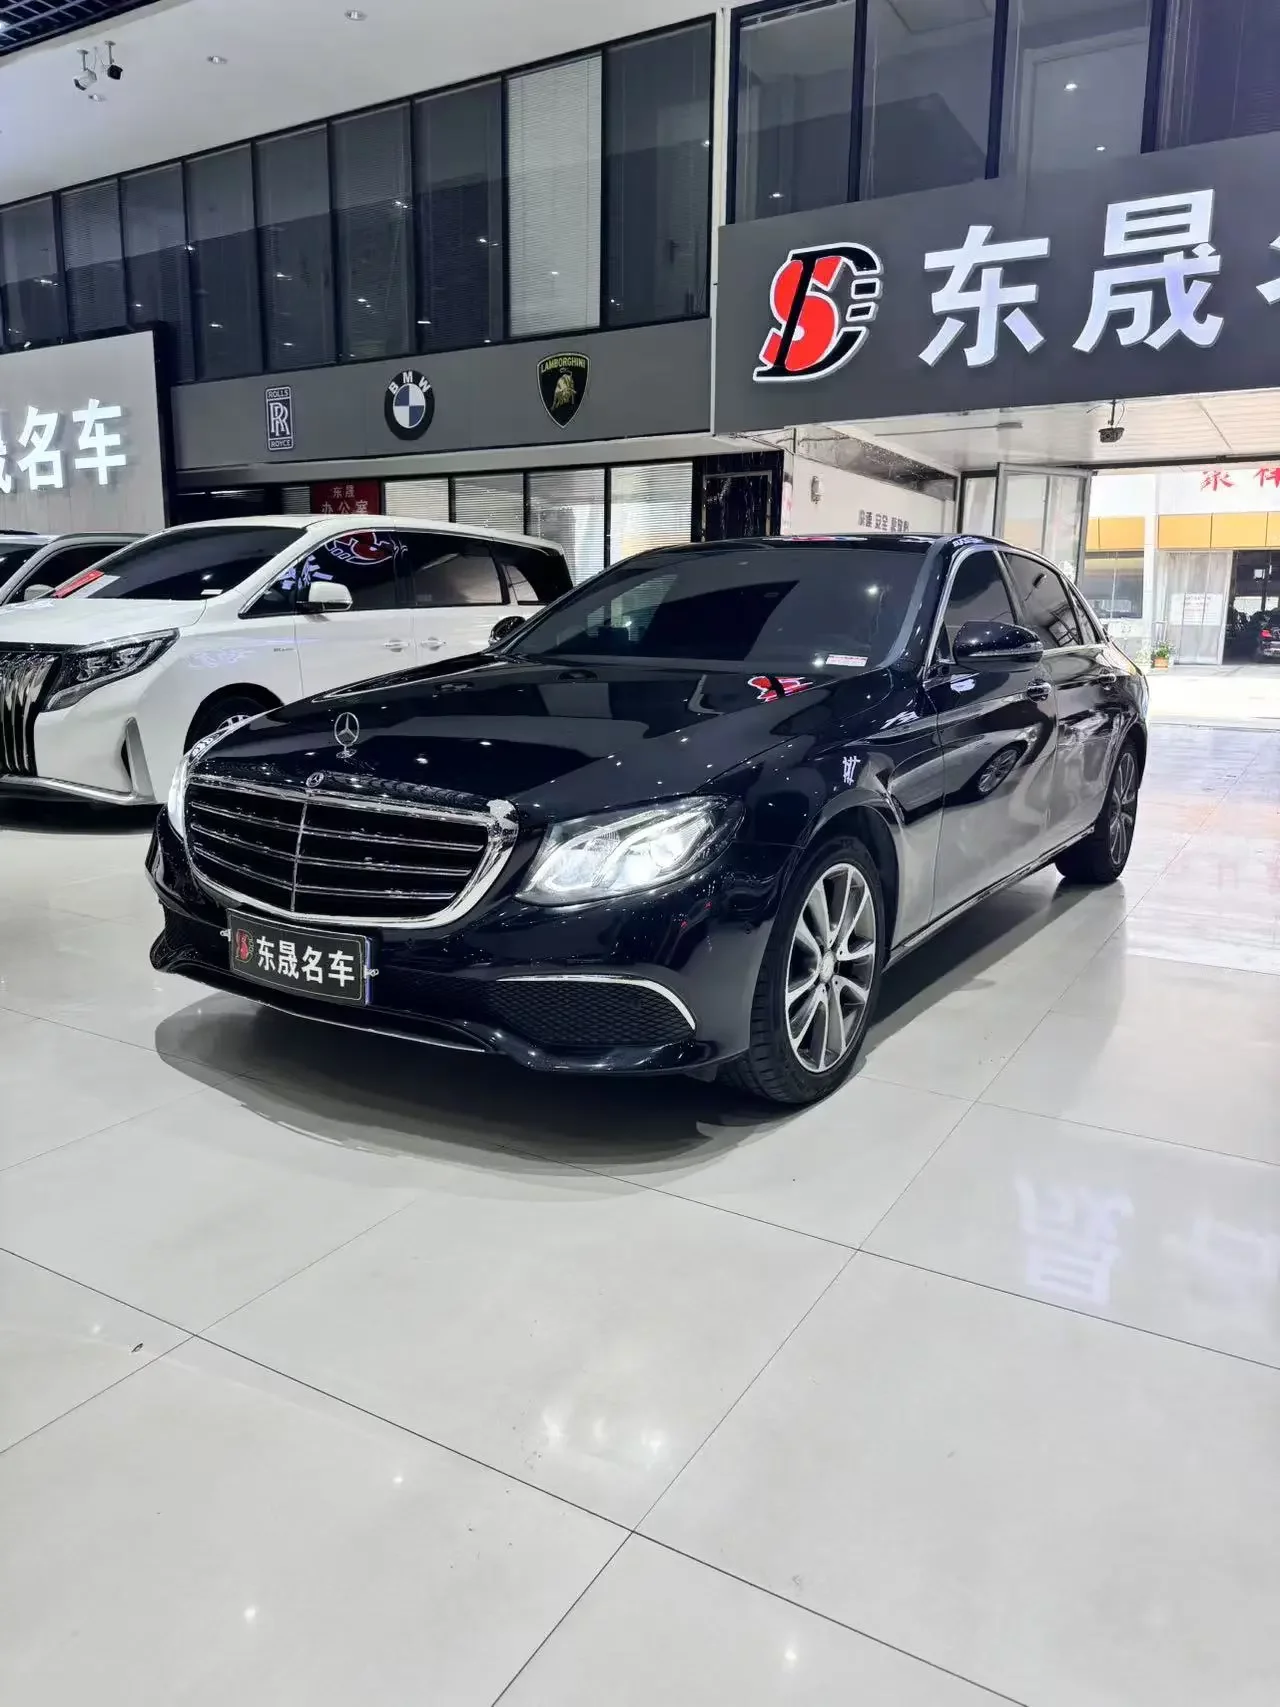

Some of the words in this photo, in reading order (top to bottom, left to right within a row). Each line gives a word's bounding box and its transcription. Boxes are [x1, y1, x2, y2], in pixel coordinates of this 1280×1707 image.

[918, 188, 1280, 367] 东晟
[541, 357, 586, 373] LAMBORGHINI
[388, 371, 431, 395] BMW
[268, 390, 289, 398] ROLLS
[271, 440, 291, 448] ROYCE
[320, 500, 369, 514] 办公室
[256, 935, 355, 988] 东晟名车
